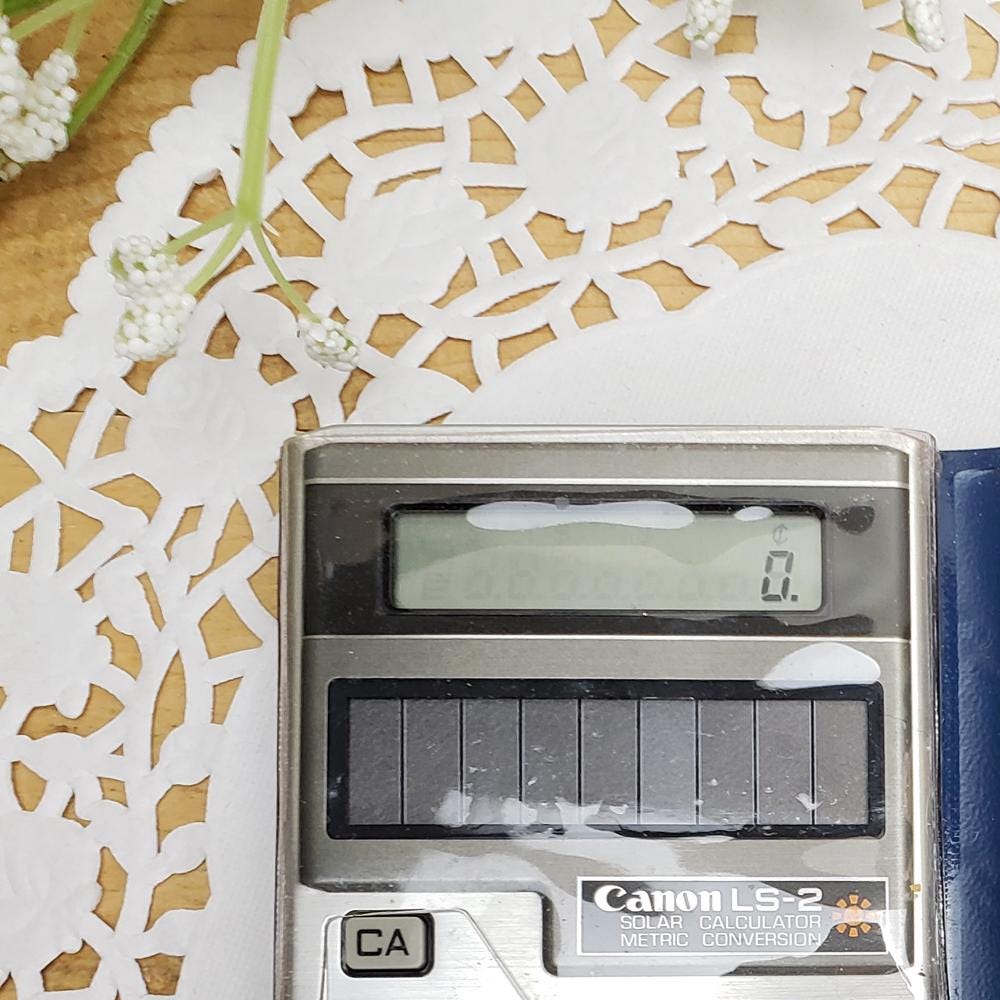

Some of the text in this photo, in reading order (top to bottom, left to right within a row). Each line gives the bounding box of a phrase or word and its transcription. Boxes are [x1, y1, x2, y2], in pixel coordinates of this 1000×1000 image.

[594, 885, 823, 912] Canon LS-2
[620, 915, 821, 929] SOLAR CALCULATOR
[356, 928, 409, 956] CA
[621, 932, 823, 947] METRIC CONVERSION
